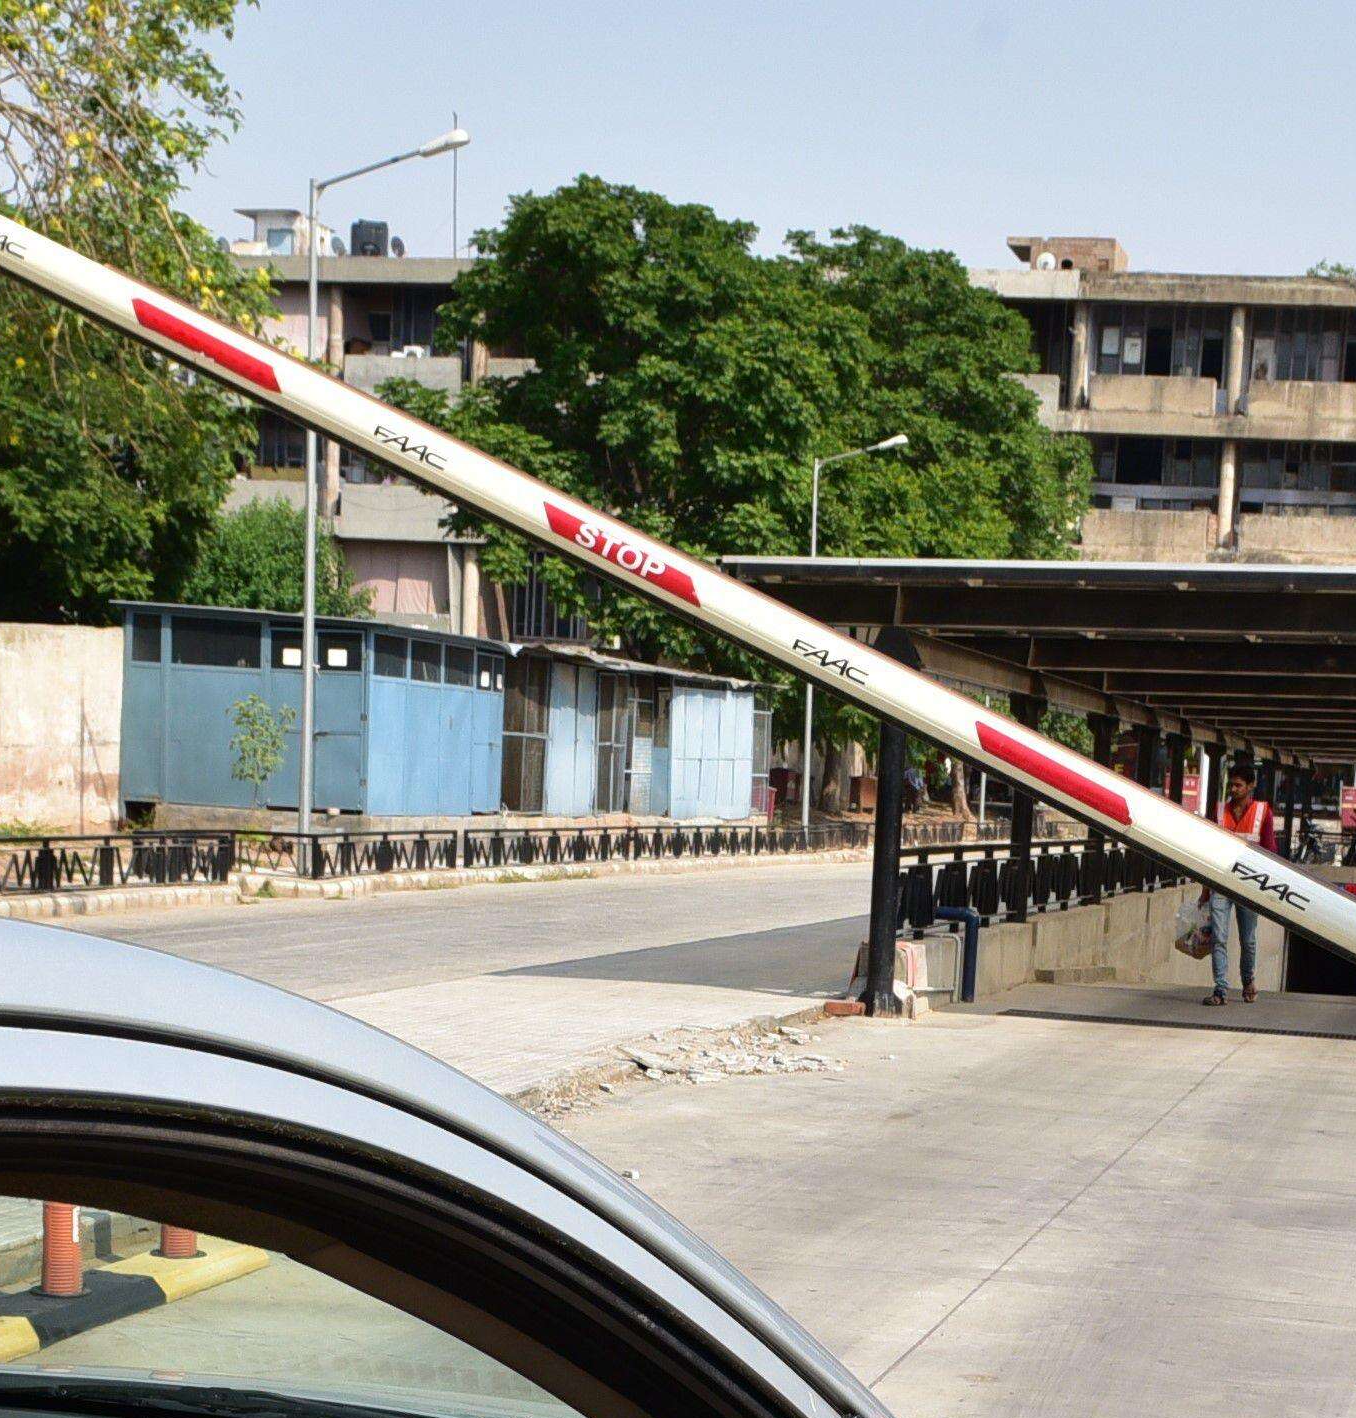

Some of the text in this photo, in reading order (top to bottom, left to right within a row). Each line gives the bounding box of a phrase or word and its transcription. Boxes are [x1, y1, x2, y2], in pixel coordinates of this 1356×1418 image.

[373, 425, 447, 471] FAAC
[575, 522, 666, 577] STOP
[792, 639, 869, 685] FAAC
[1231, 861, 1311, 911] FAAC
